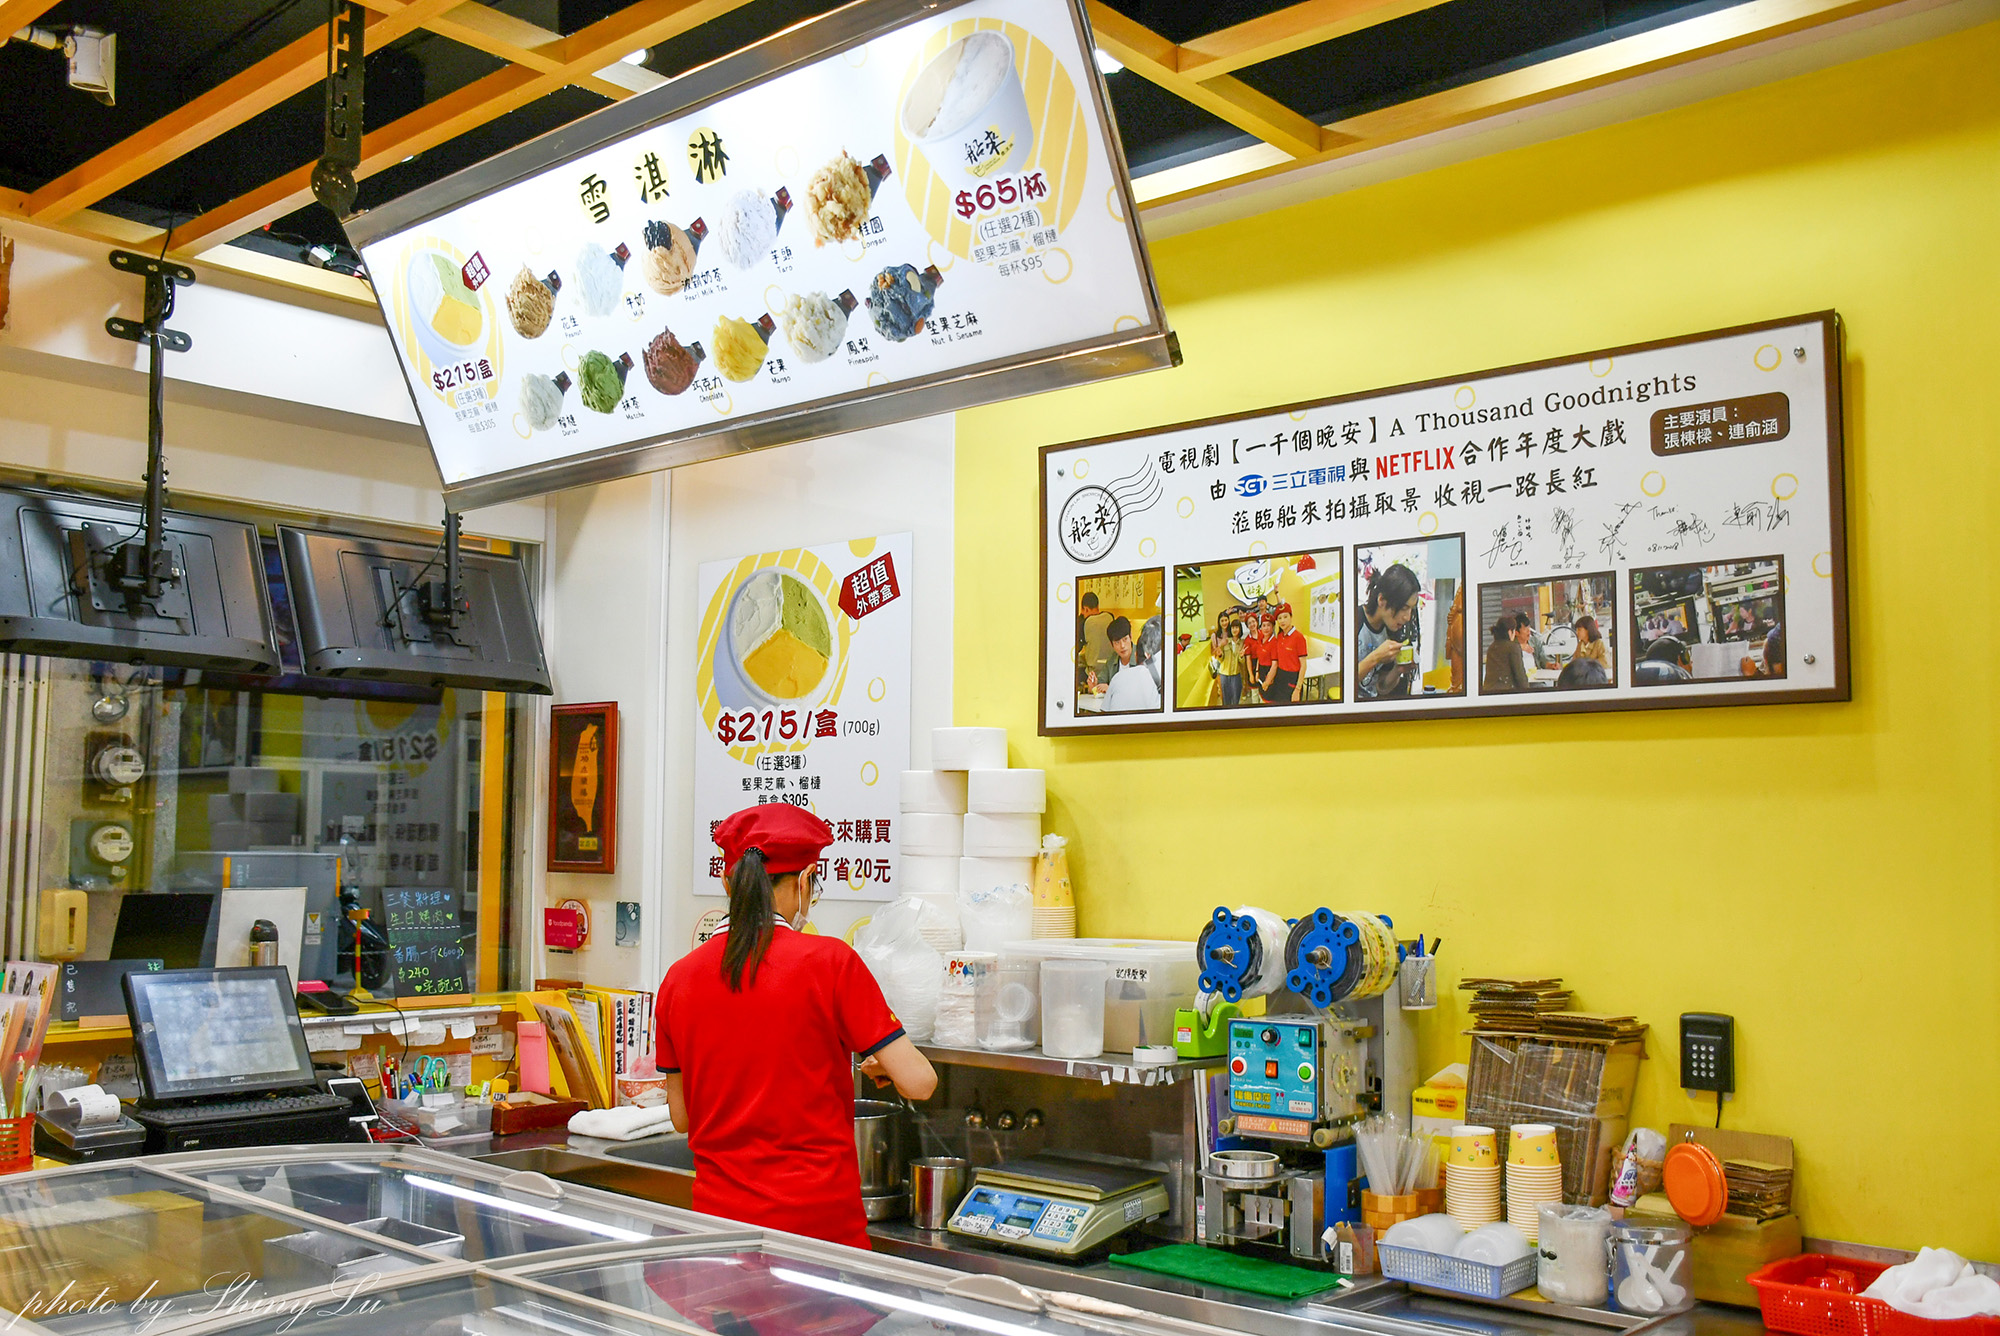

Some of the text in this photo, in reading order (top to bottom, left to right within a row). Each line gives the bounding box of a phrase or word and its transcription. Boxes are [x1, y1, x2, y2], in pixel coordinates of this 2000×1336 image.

[580, 131, 730, 224] 雪淇淋
[955, 173, 1047, 220] $65/杯
[979, 209, 1041, 241] (任選2種)
[861, 237, 887, 250] Longan
[777, 265, 794, 274] Taro
[998, 255, 1043, 278] 每杯$95
[925, 311, 979, 335] 堅果芝麻
[931, 337, 946, 346] Nut
[956, 329, 983, 341] Sesame
[433, 358, 494, 392] $215/盒
[847, 354, 880, 366] Pineapple
[692, 376, 724, 394] 巧克力
[771, 375, 792, 385] Mango
[1389, 418, 1406, 437] A
[1415, 397, 1534, 433] Thousand
[1544, 373, 1697, 413] Goodnights
[1375, 446, 1455, 480] NETFLIX
[1459, 418, 1628, 467] 合作年度大戲
[1433, 465, 1598, 510] 收視一路長紅
[851, 559, 890, 599] 超值
[856, 584, 894, 616] 外帶盒
[717, 708, 881, 746] $215/盒 (700g)
[756, 754, 807, 772] (任選3種)
